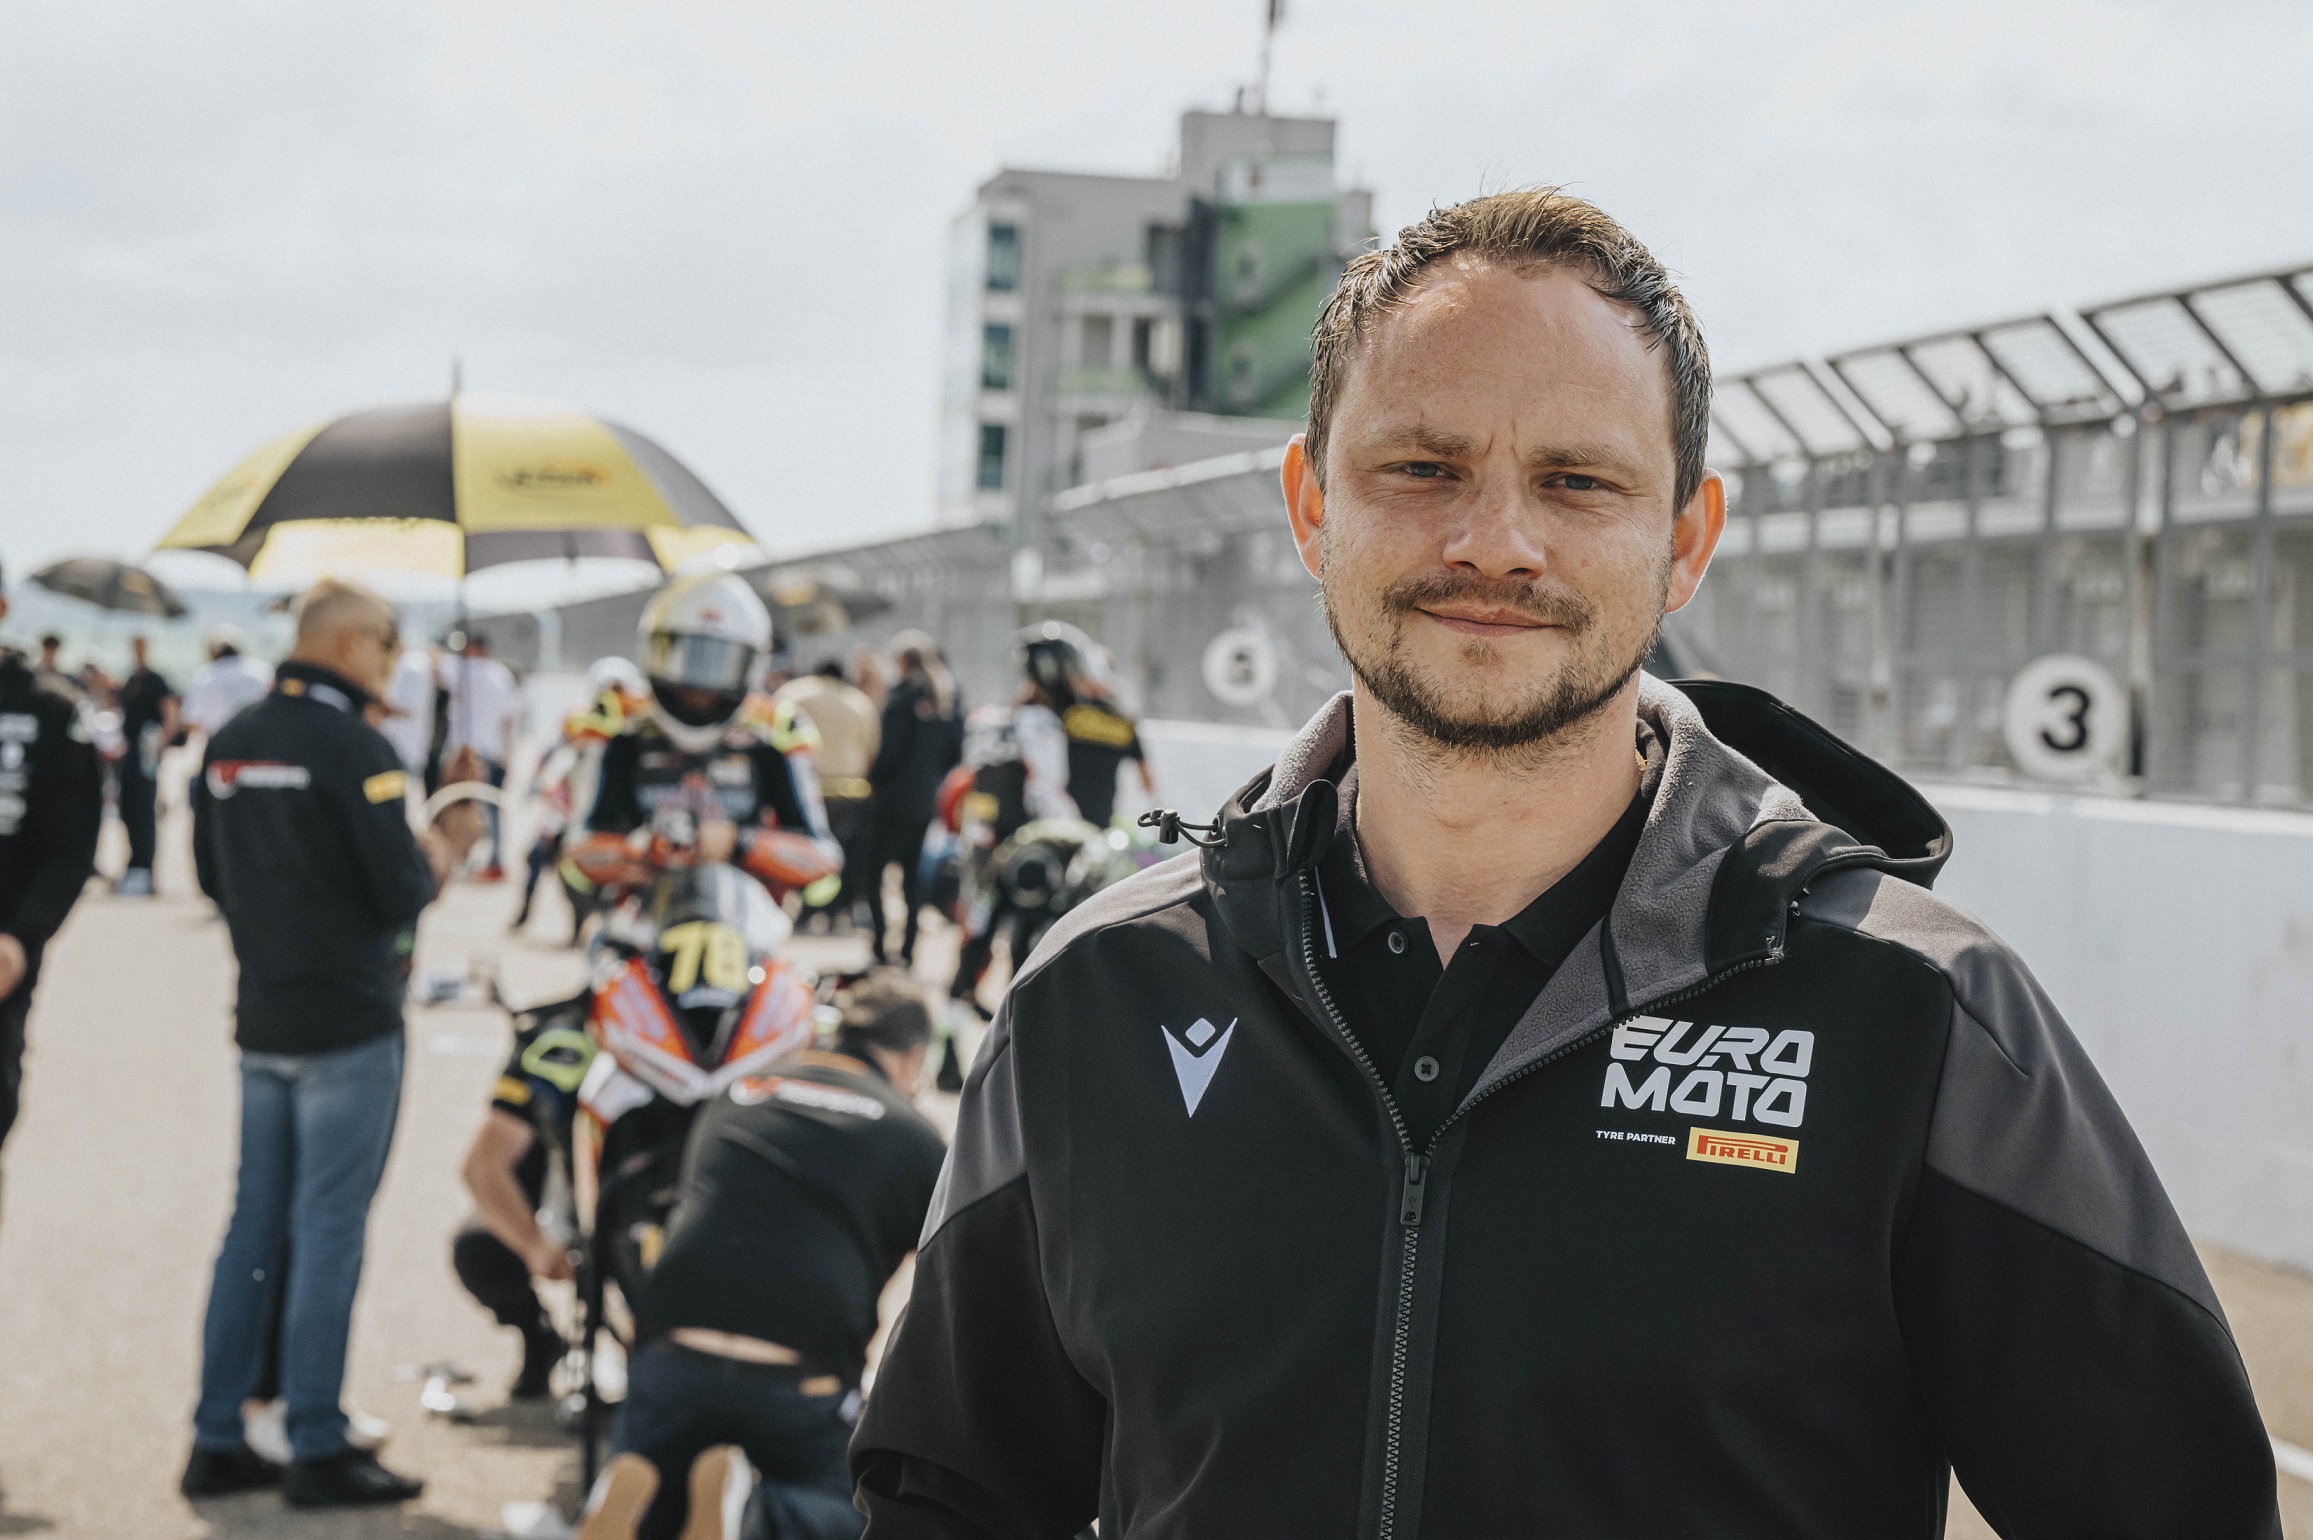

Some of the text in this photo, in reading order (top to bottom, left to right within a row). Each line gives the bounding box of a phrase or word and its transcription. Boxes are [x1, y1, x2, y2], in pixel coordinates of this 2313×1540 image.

[2042, 685, 2090, 752] 3
[1610, 1015, 1814, 1077] EURO
[1601, 1062, 1807, 1127] MOTO
[1596, 1130, 1676, 1145] TYRE PARTNER
[1697, 1135, 1788, 1165] PIRELLI
